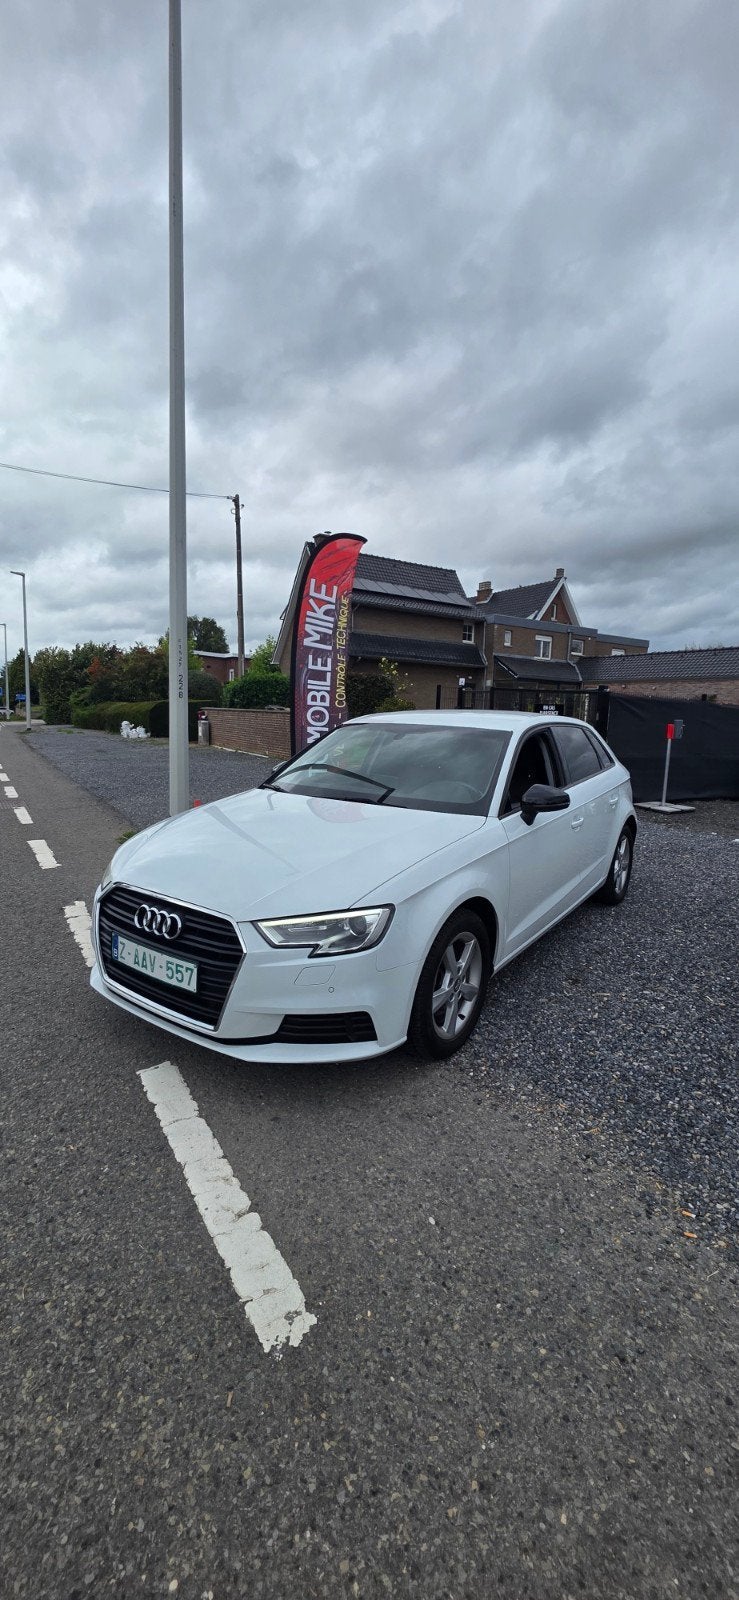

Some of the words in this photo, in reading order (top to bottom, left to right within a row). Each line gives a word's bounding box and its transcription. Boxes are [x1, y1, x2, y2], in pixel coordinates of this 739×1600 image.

[303, 578, 338, 651] MIKE
[336, 595, 350, 650] TECHNIQUE
[335, 653, 347, 708] CONTRÔLE
